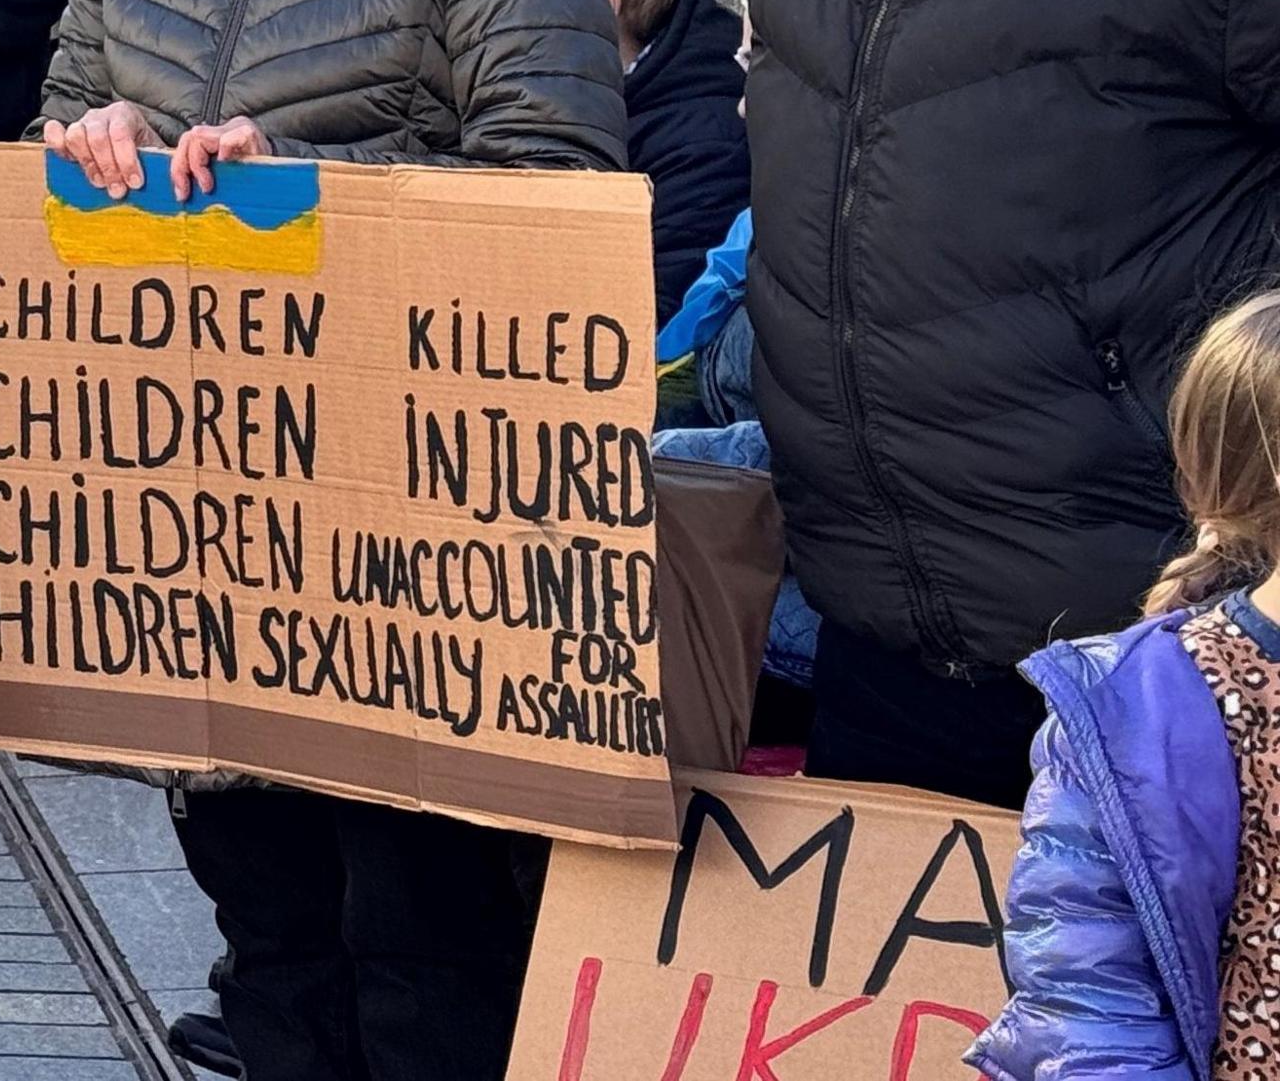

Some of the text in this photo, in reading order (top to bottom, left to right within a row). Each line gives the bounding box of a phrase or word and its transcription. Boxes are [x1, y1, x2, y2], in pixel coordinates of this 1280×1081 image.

[332, 527, 657, 646] UNACCOUNTED
[252, 607, 483, 737] SEXUALLY
[552, 629, 646, 695] FOR
